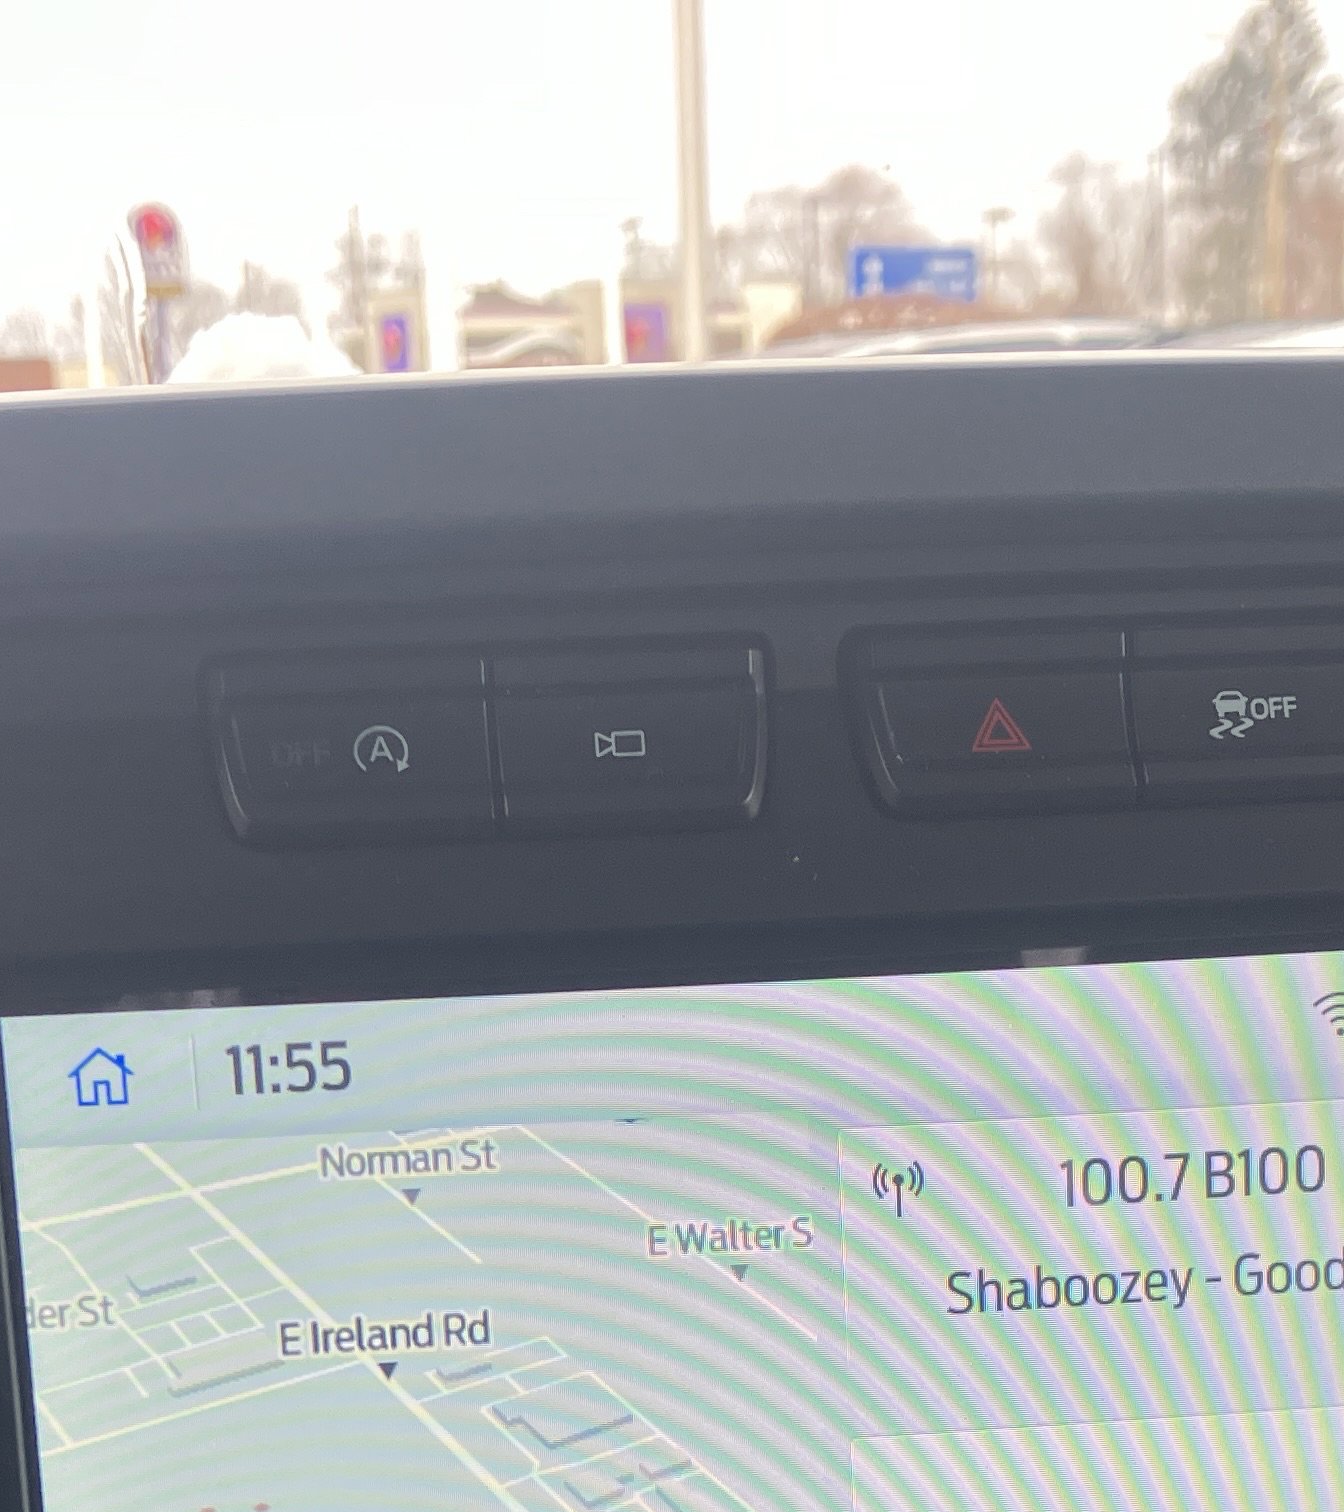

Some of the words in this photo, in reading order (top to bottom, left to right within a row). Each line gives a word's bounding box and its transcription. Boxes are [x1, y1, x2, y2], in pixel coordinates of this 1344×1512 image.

[1250, 695, 1297, 720] OFF
[225, 1041, 353, 1096] 11:55
[320, 1144, 454, 1178] Norman
[459, 1140, 497, 1170] St
[1060, 1153, 1192, 1208] 100.7
[1203, 1144, 1328, 1199] B100
[649, 1225, 668, 1256] E
[674, 1219, 785, 1254] Walter
[791, 1216, 813, 1248] S
[78, 1295, 116, 1326] St
[946, 1265, 1193, 1316] Shaboozey
[280, 1323, 301, 1356] E
[309, 1315, 434, 1352] Ireland
[443, 1310, 491, 1346] Rd
